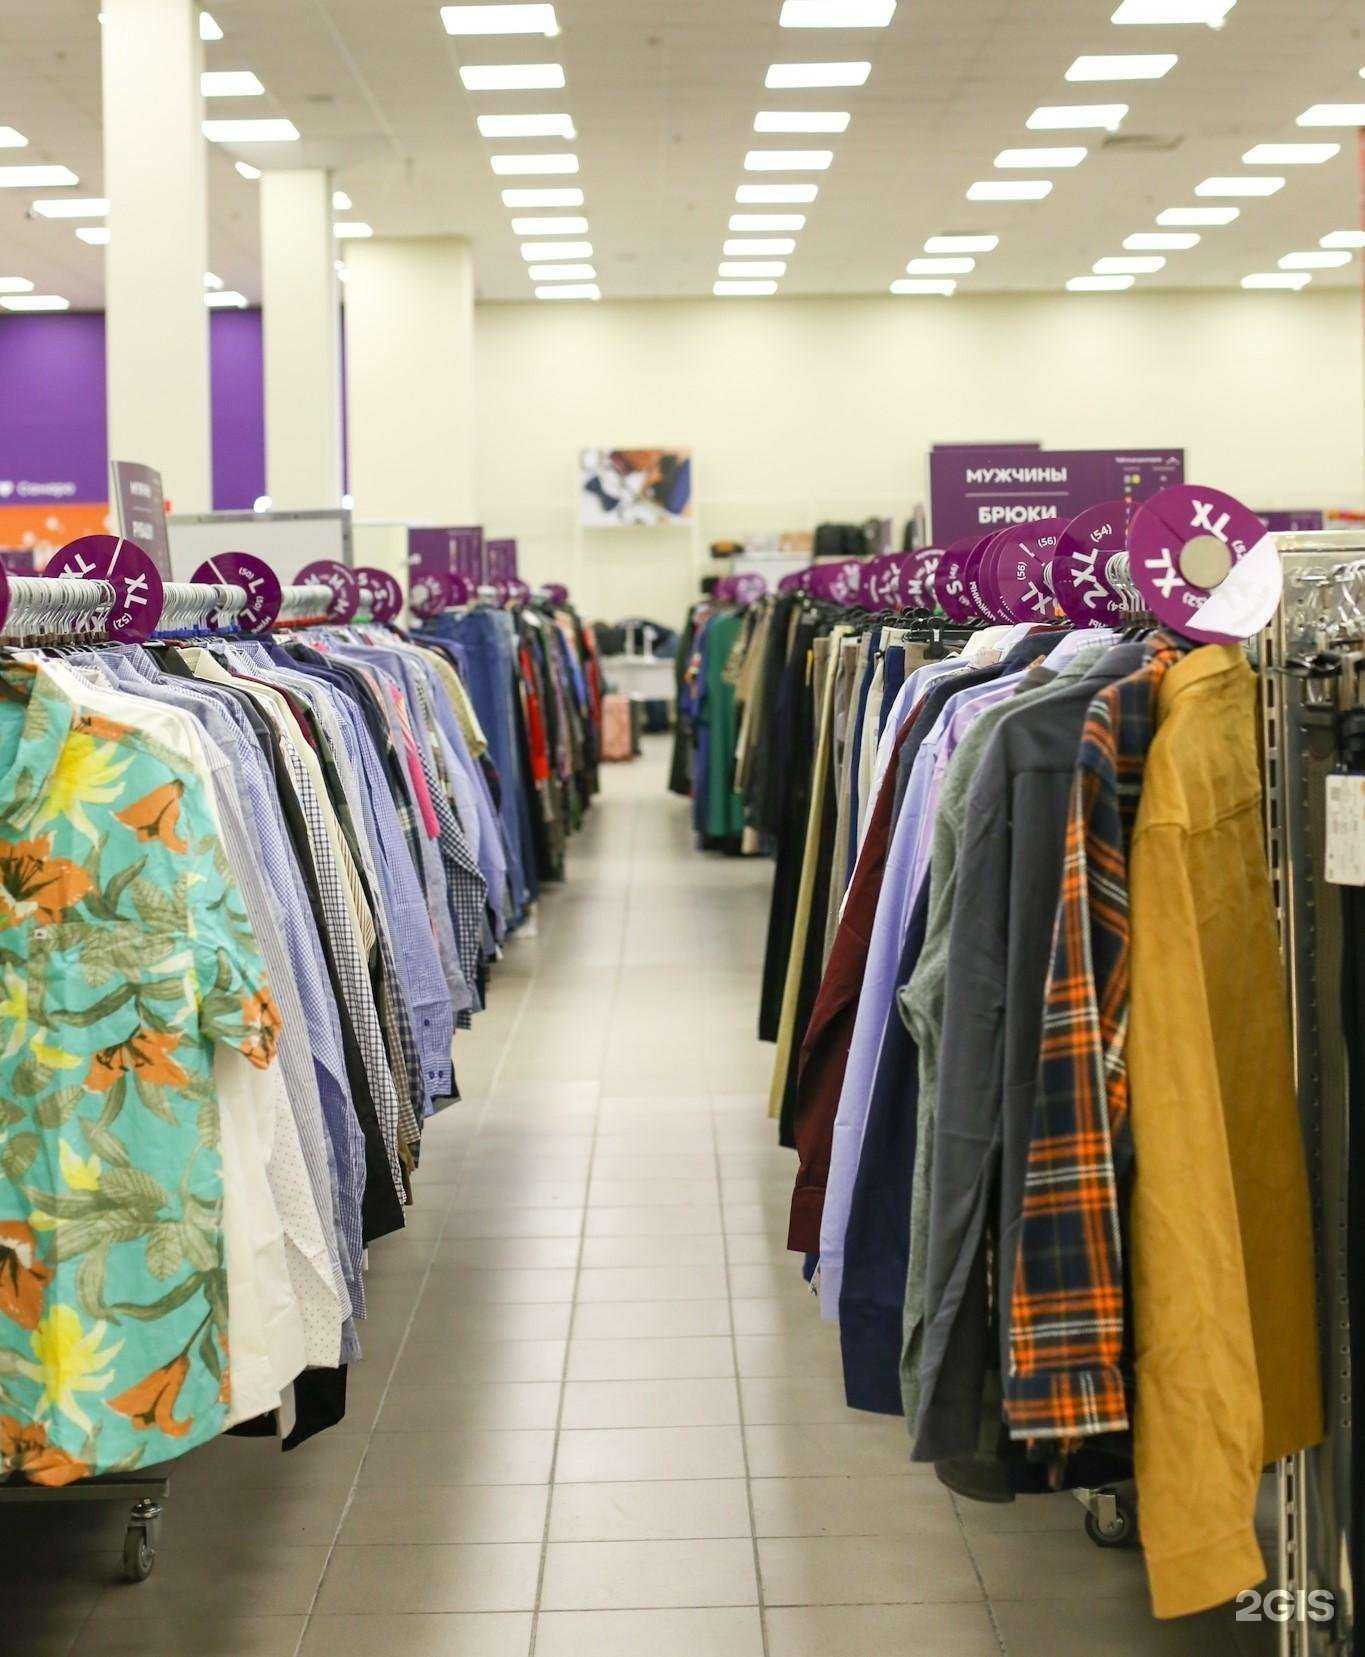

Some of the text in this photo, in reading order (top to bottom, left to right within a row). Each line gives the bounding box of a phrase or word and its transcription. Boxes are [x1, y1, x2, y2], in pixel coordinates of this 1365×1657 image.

[966, 467, 1067, 484] МУЖЧИНЫ
[977, 505, 1058, 525] БРЮКИ
[1190, 500, 1231, 542] XL
[1037, 536, 1057, 548] (56)
[1090, 524, 1112, 542] (54)
[238, 566, 255, 579] (50)
[1016, 561, 1028, 581] (56)
[1071, 548, 1109, 609] 2XL
[1144, 548, 1185, 598] XL
[123, 573, 149, 609] XL
[248, 577, 265, 594] L
[945, 580, 963, 596] S
[113, 612, 133, 631] (52)
[240, 607, 257, 623] L
